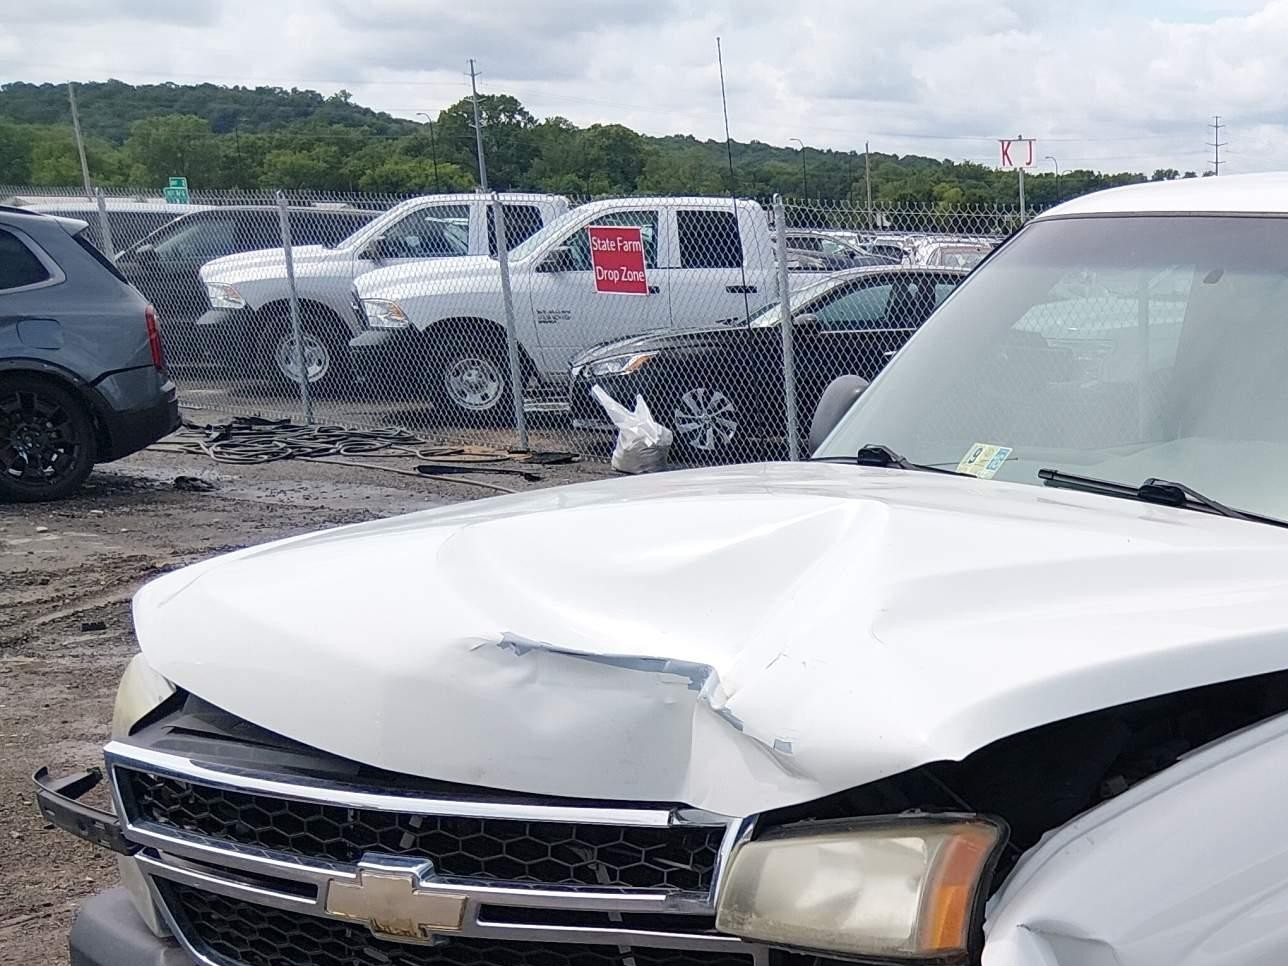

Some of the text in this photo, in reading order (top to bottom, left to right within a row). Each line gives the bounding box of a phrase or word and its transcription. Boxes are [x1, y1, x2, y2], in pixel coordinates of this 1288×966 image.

[1001, 140, 1032, 166] K J
[592, 237, 642, 252] State Farm
[596, 266, 645, 284] Drop Zone
